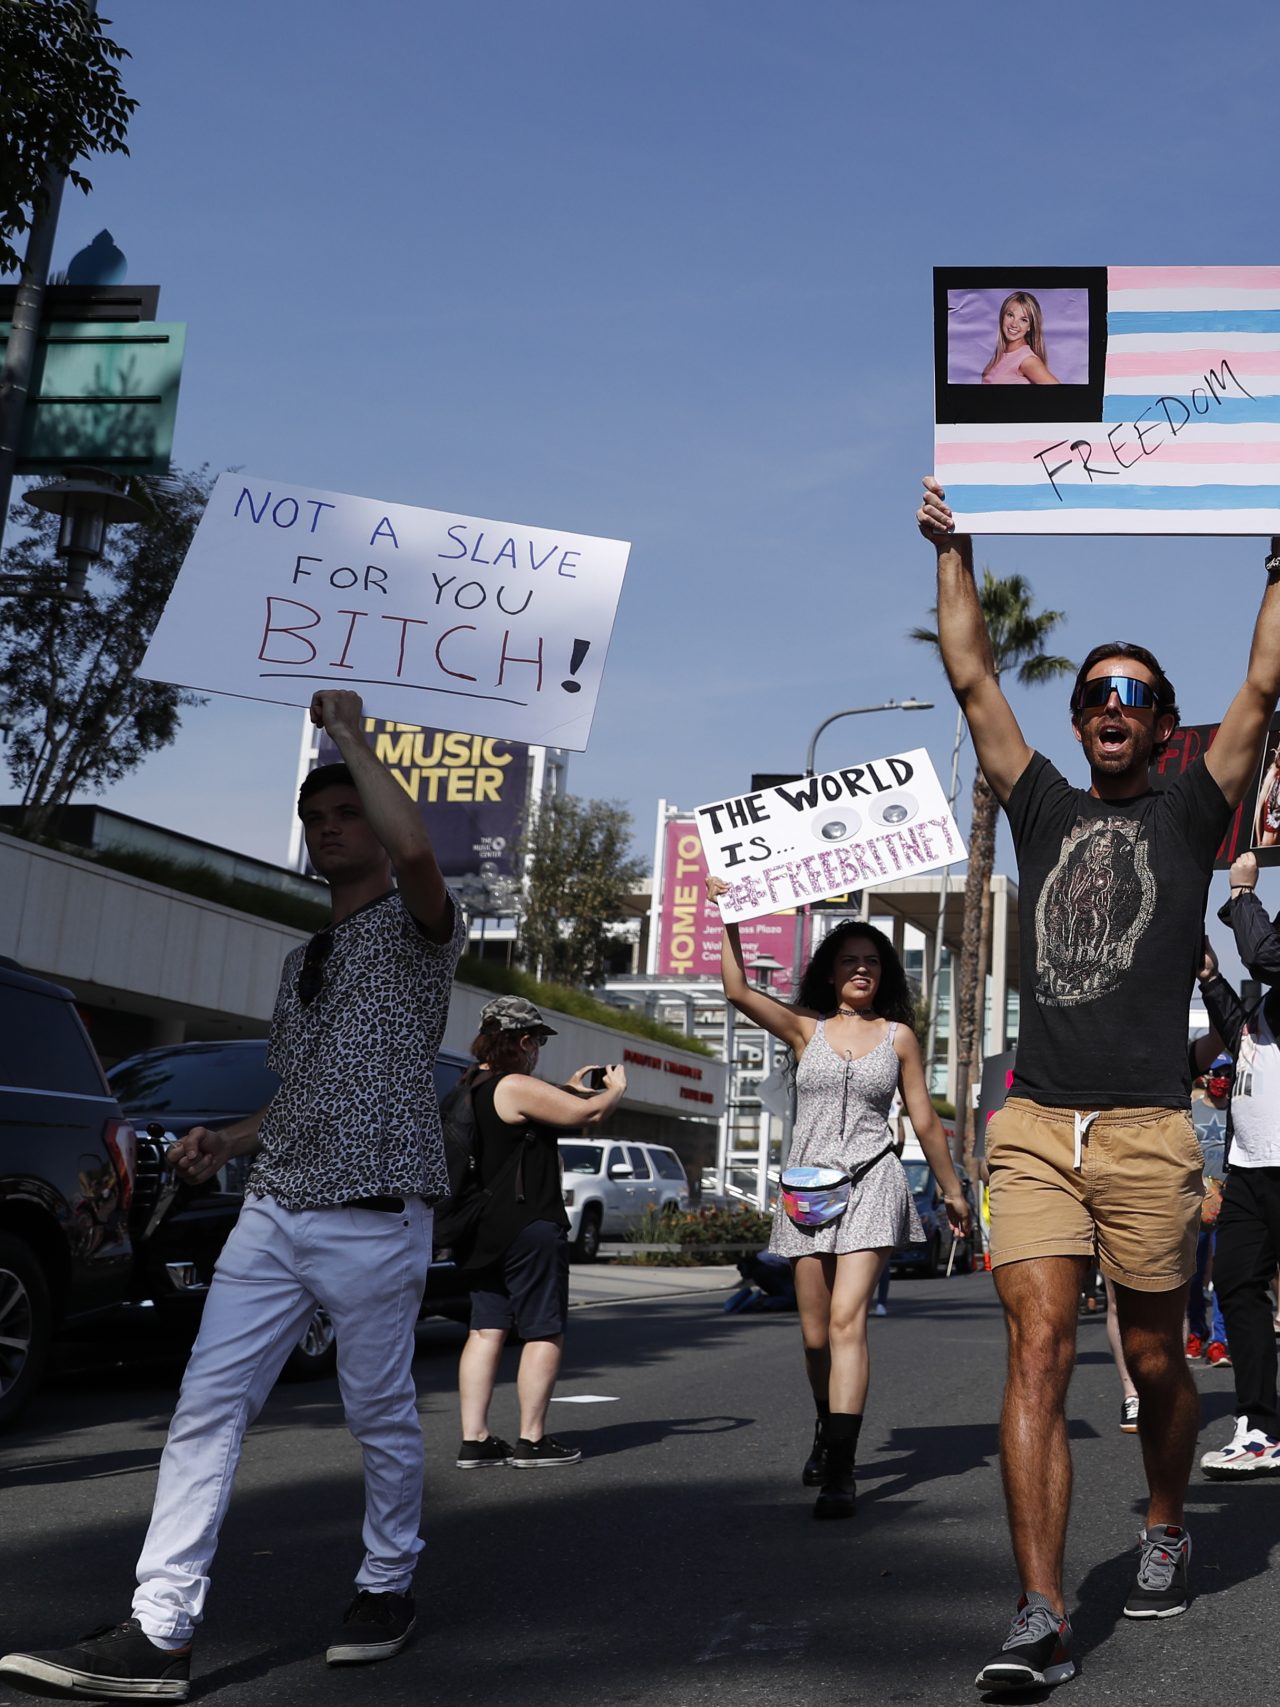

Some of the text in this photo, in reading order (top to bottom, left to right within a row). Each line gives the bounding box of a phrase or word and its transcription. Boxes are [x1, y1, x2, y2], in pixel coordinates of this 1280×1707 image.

[1033, 359, 1257, 502] FREEDOM
[233, 487, 582, 579] NOT A SLAVE
[293, 555, 533, 616] FOR YOU
[257, 596, 591, 694] BITCH!
[376, 733, 513, 767] MUSIC
[392, 767, 505, 803] NTER
[698, 758, 914, 835] THE WORLD
[676, 834, 702, 879] TO
[720, 836, 795, 868] IS...
[722, 815, 955, 913] #FREEBRITNEY
